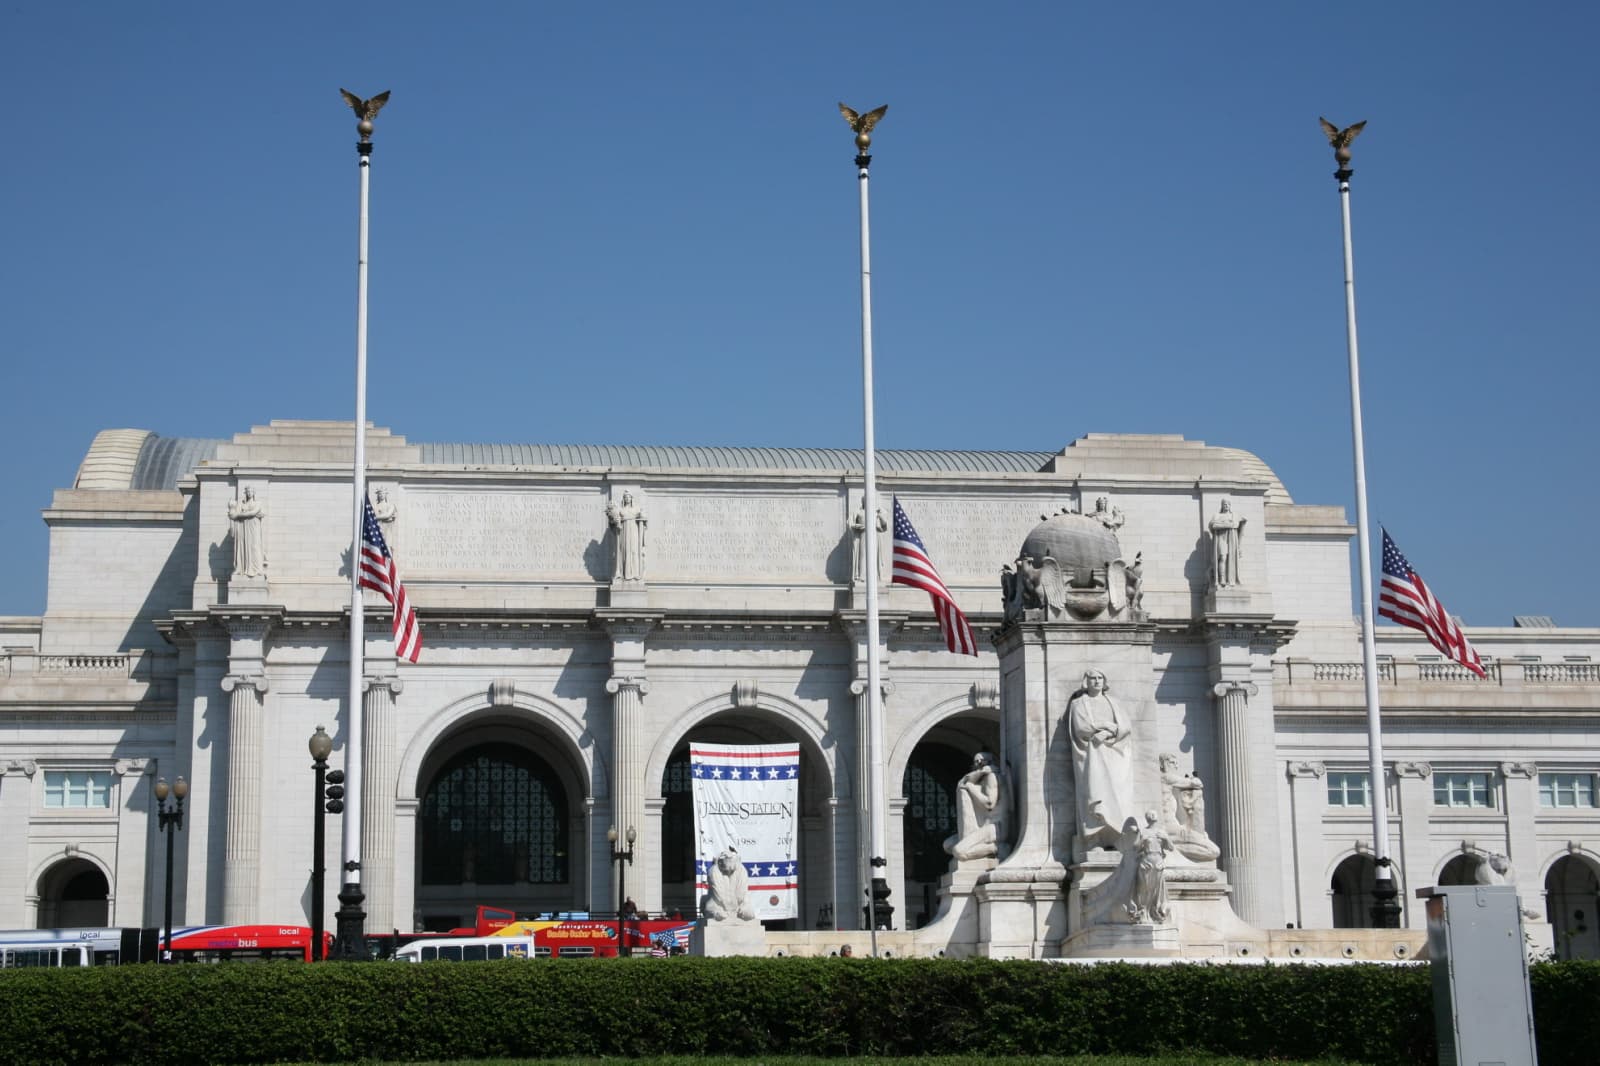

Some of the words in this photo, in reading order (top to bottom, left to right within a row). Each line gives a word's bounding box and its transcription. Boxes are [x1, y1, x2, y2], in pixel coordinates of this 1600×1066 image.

[697, 801, 739, 818] UNION
[739, 801, 792, 820] STATION
[79, 930, 101, 940] local
[279, 927, 300, 936] local
